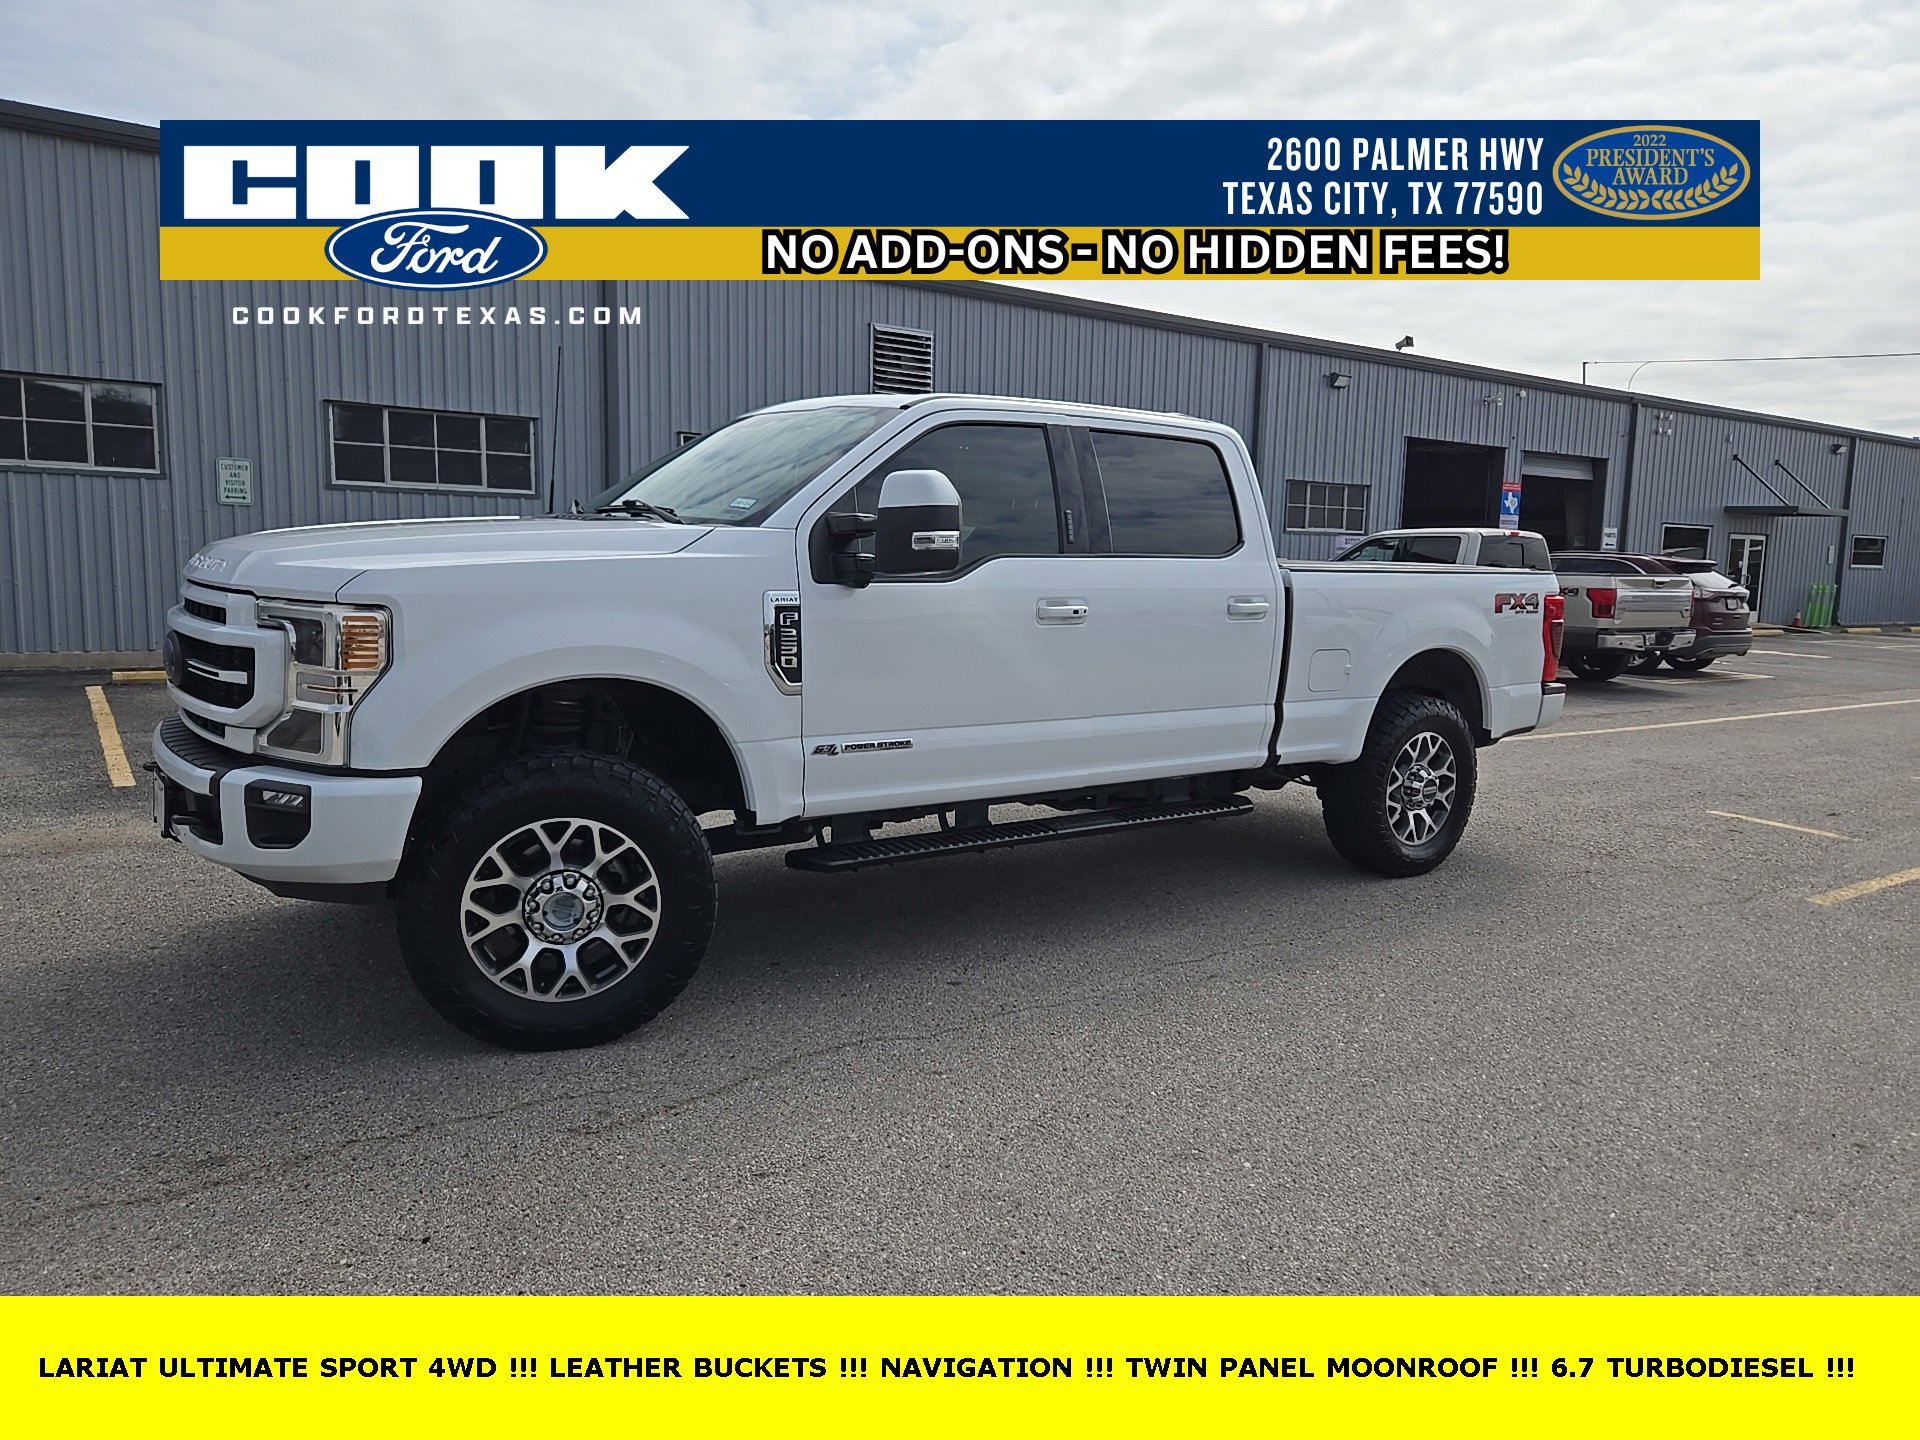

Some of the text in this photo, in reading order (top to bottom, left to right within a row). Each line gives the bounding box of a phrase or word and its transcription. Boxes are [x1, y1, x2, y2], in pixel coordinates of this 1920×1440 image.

[1494, 593, 1539, 613] FX4
[844, 743, 876, 751] POWER
[876, 739, 912, 749] STROKE
